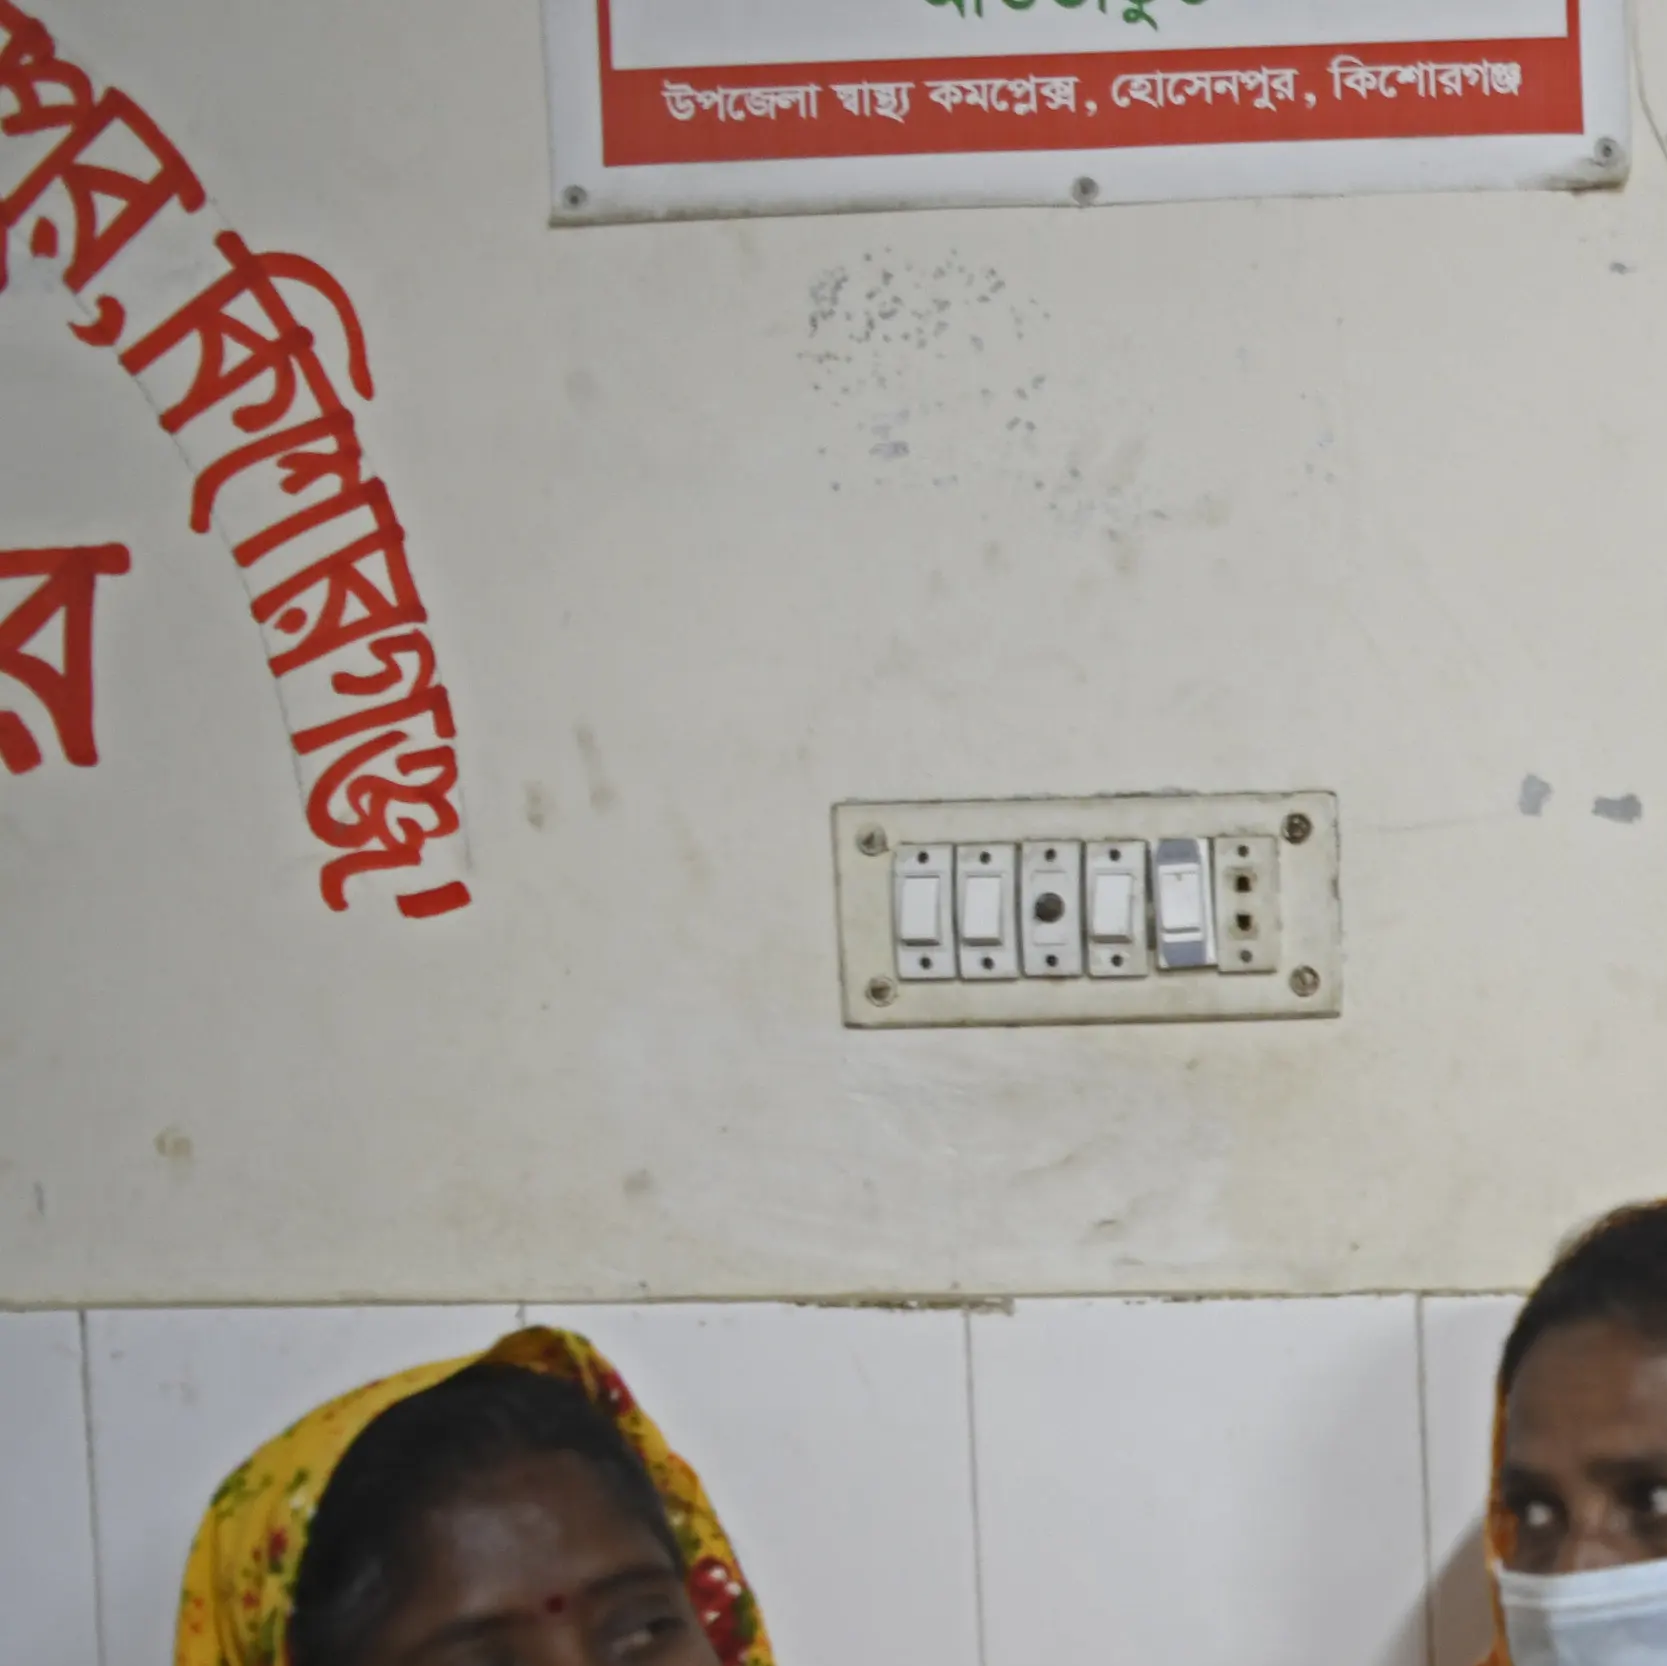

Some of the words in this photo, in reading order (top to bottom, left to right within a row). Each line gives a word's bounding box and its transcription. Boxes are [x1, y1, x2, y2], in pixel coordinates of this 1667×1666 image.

[662, 79, 822, 122] উপজেলা
[829, 80, 915, 124] স্বাস্থ্য
[1111, 65, 1318, 112] হোসেনপুর,
[1327, 53, 1523, 100] কিশোরগঞ্জ
